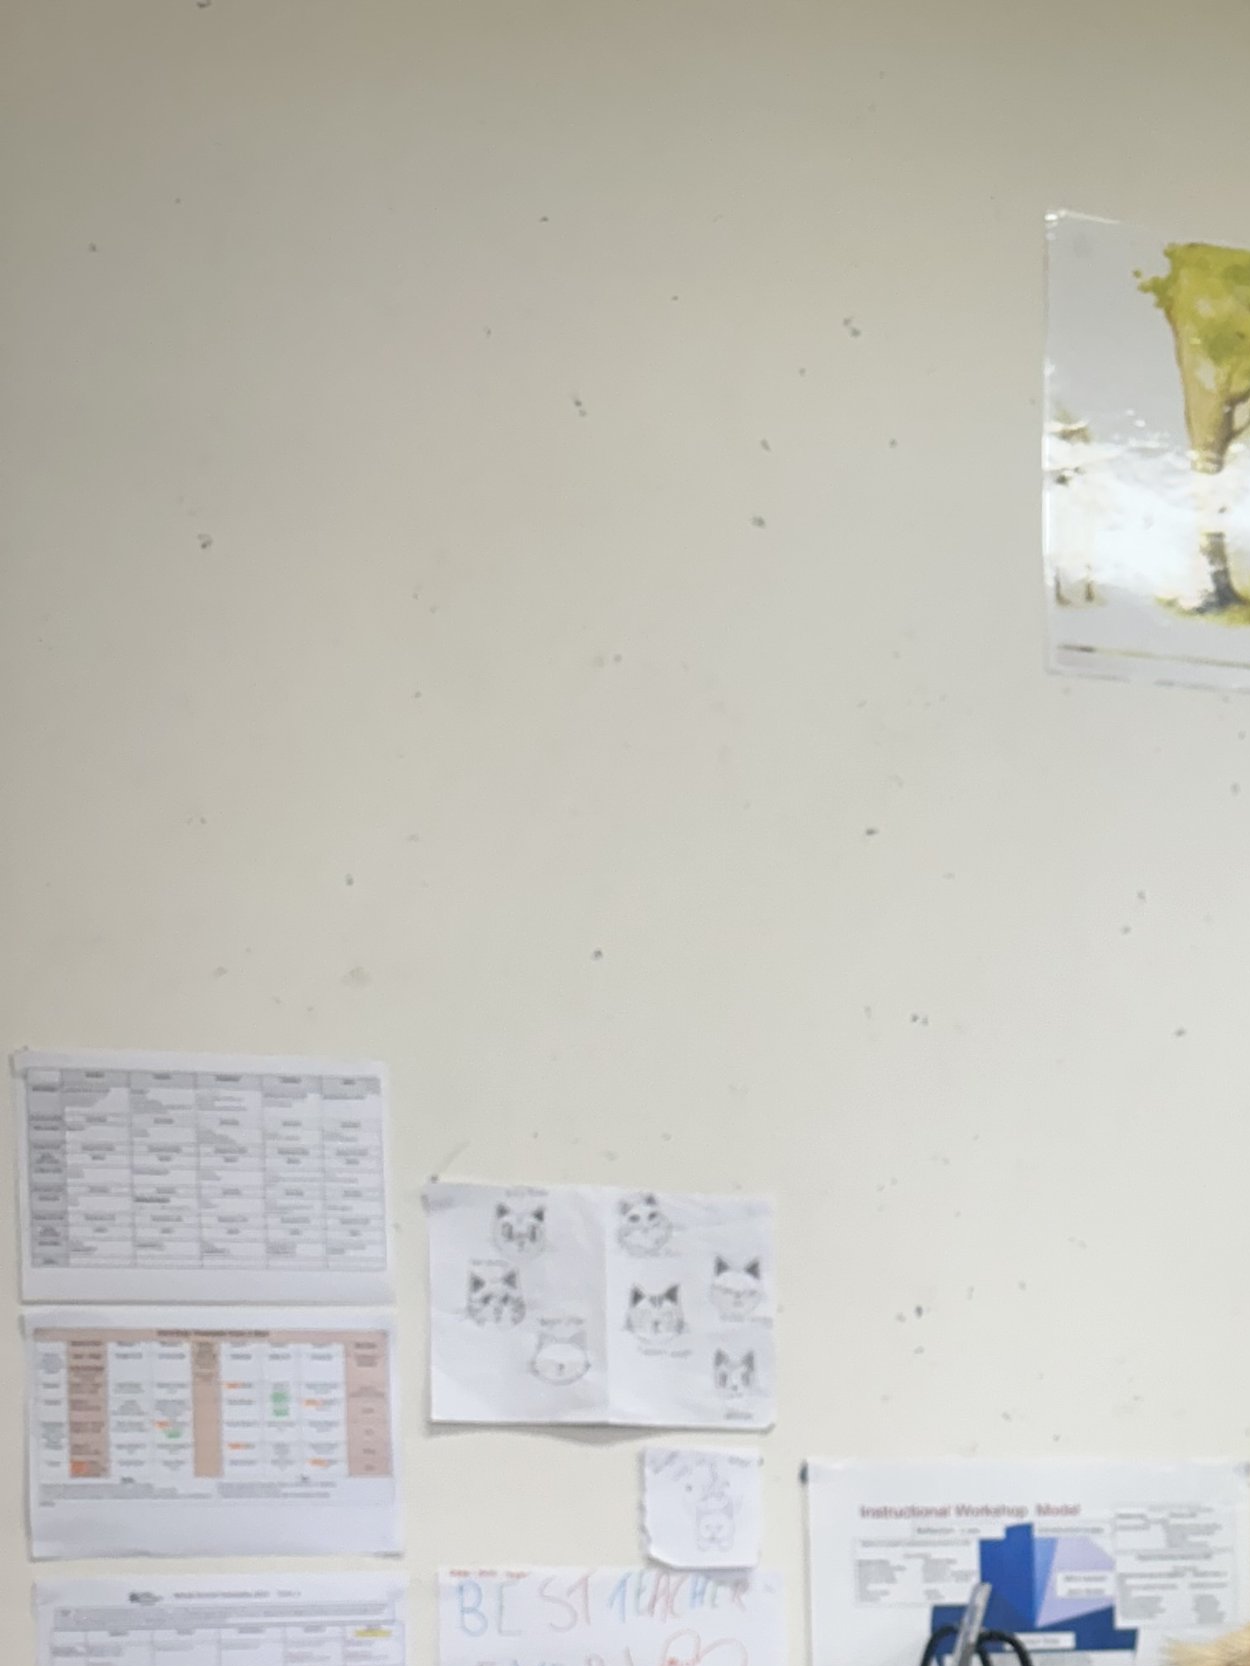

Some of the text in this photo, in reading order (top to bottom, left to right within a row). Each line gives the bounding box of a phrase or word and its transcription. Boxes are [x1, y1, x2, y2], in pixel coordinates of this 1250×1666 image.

[859, 1504, 1080, 1519] Instructional Workshop Model
[456, 1573, 592, 1637] BEST
